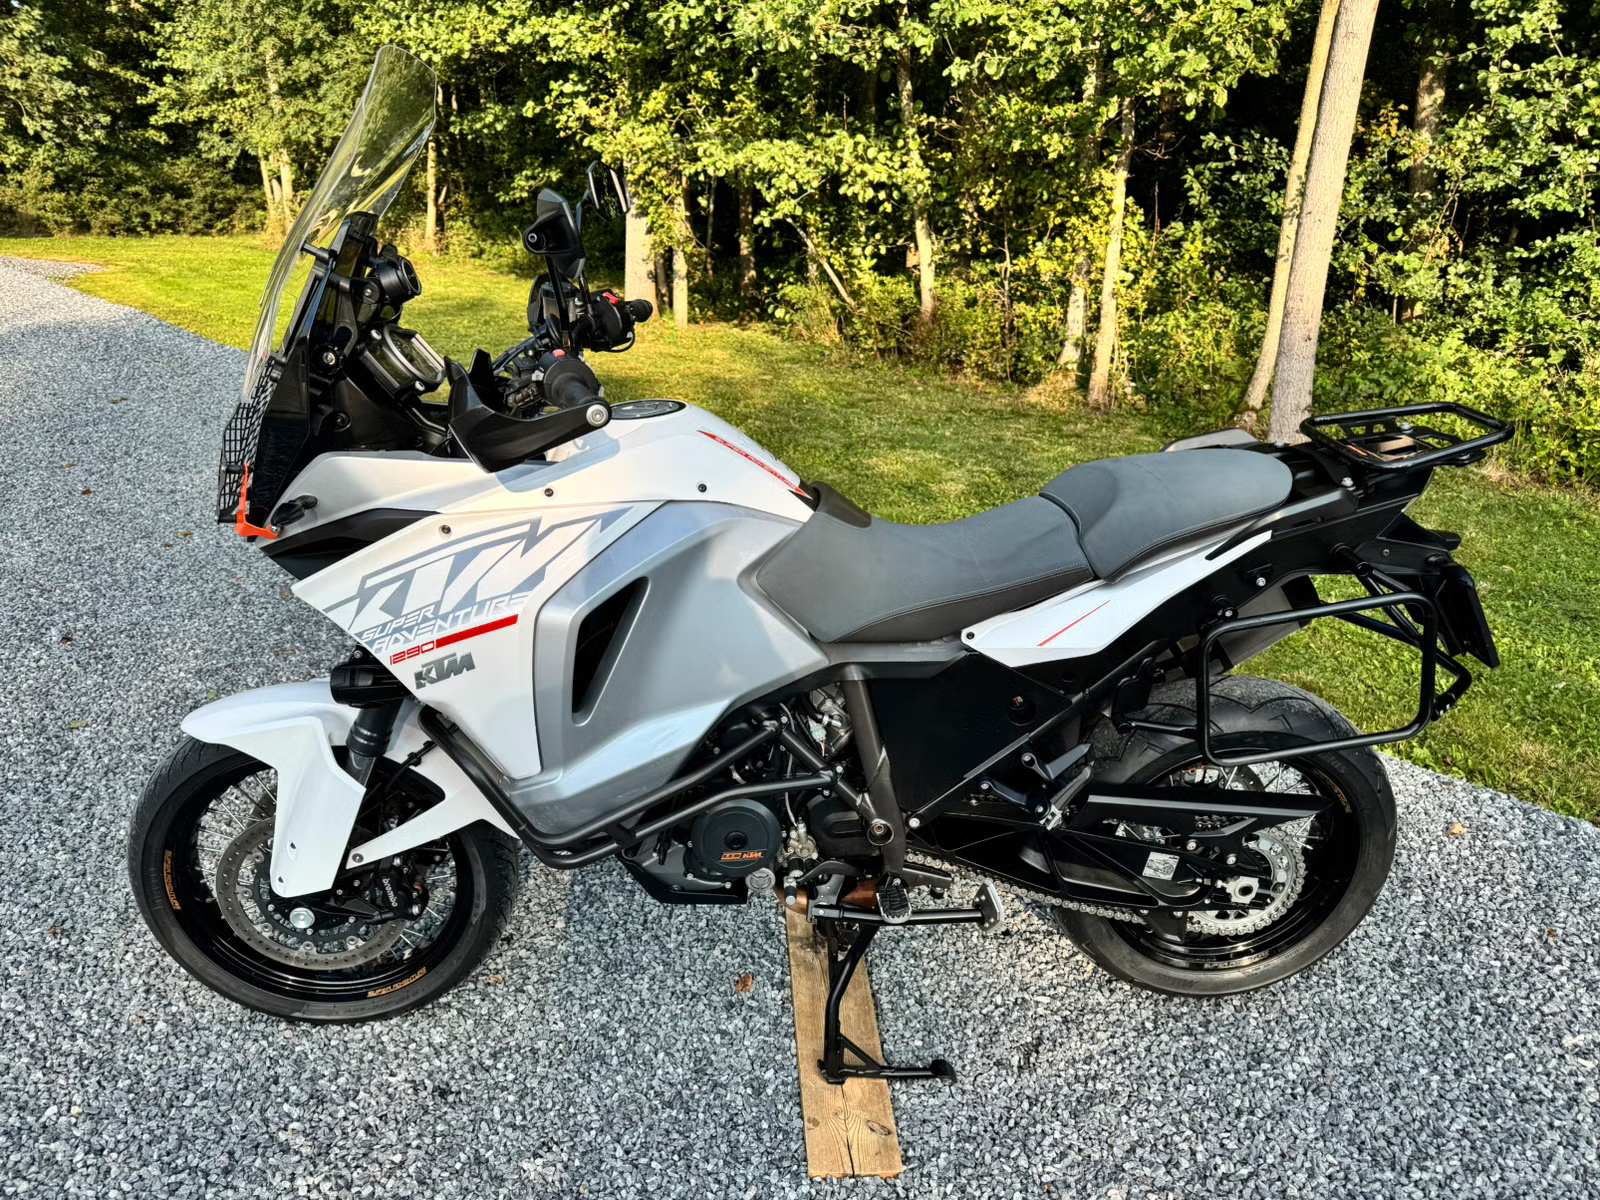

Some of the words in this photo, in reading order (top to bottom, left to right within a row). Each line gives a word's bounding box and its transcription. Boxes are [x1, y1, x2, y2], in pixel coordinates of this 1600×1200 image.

[325, 507, 627, 630] KTM
[360, 602, 435, 644] SUPER
[373, 594, 529, 654] ADVENTURE
[389, 640, 435, 666] 1290
[413, 651, 476, 690] KTM
[382, 877, 398, 907] brembo
